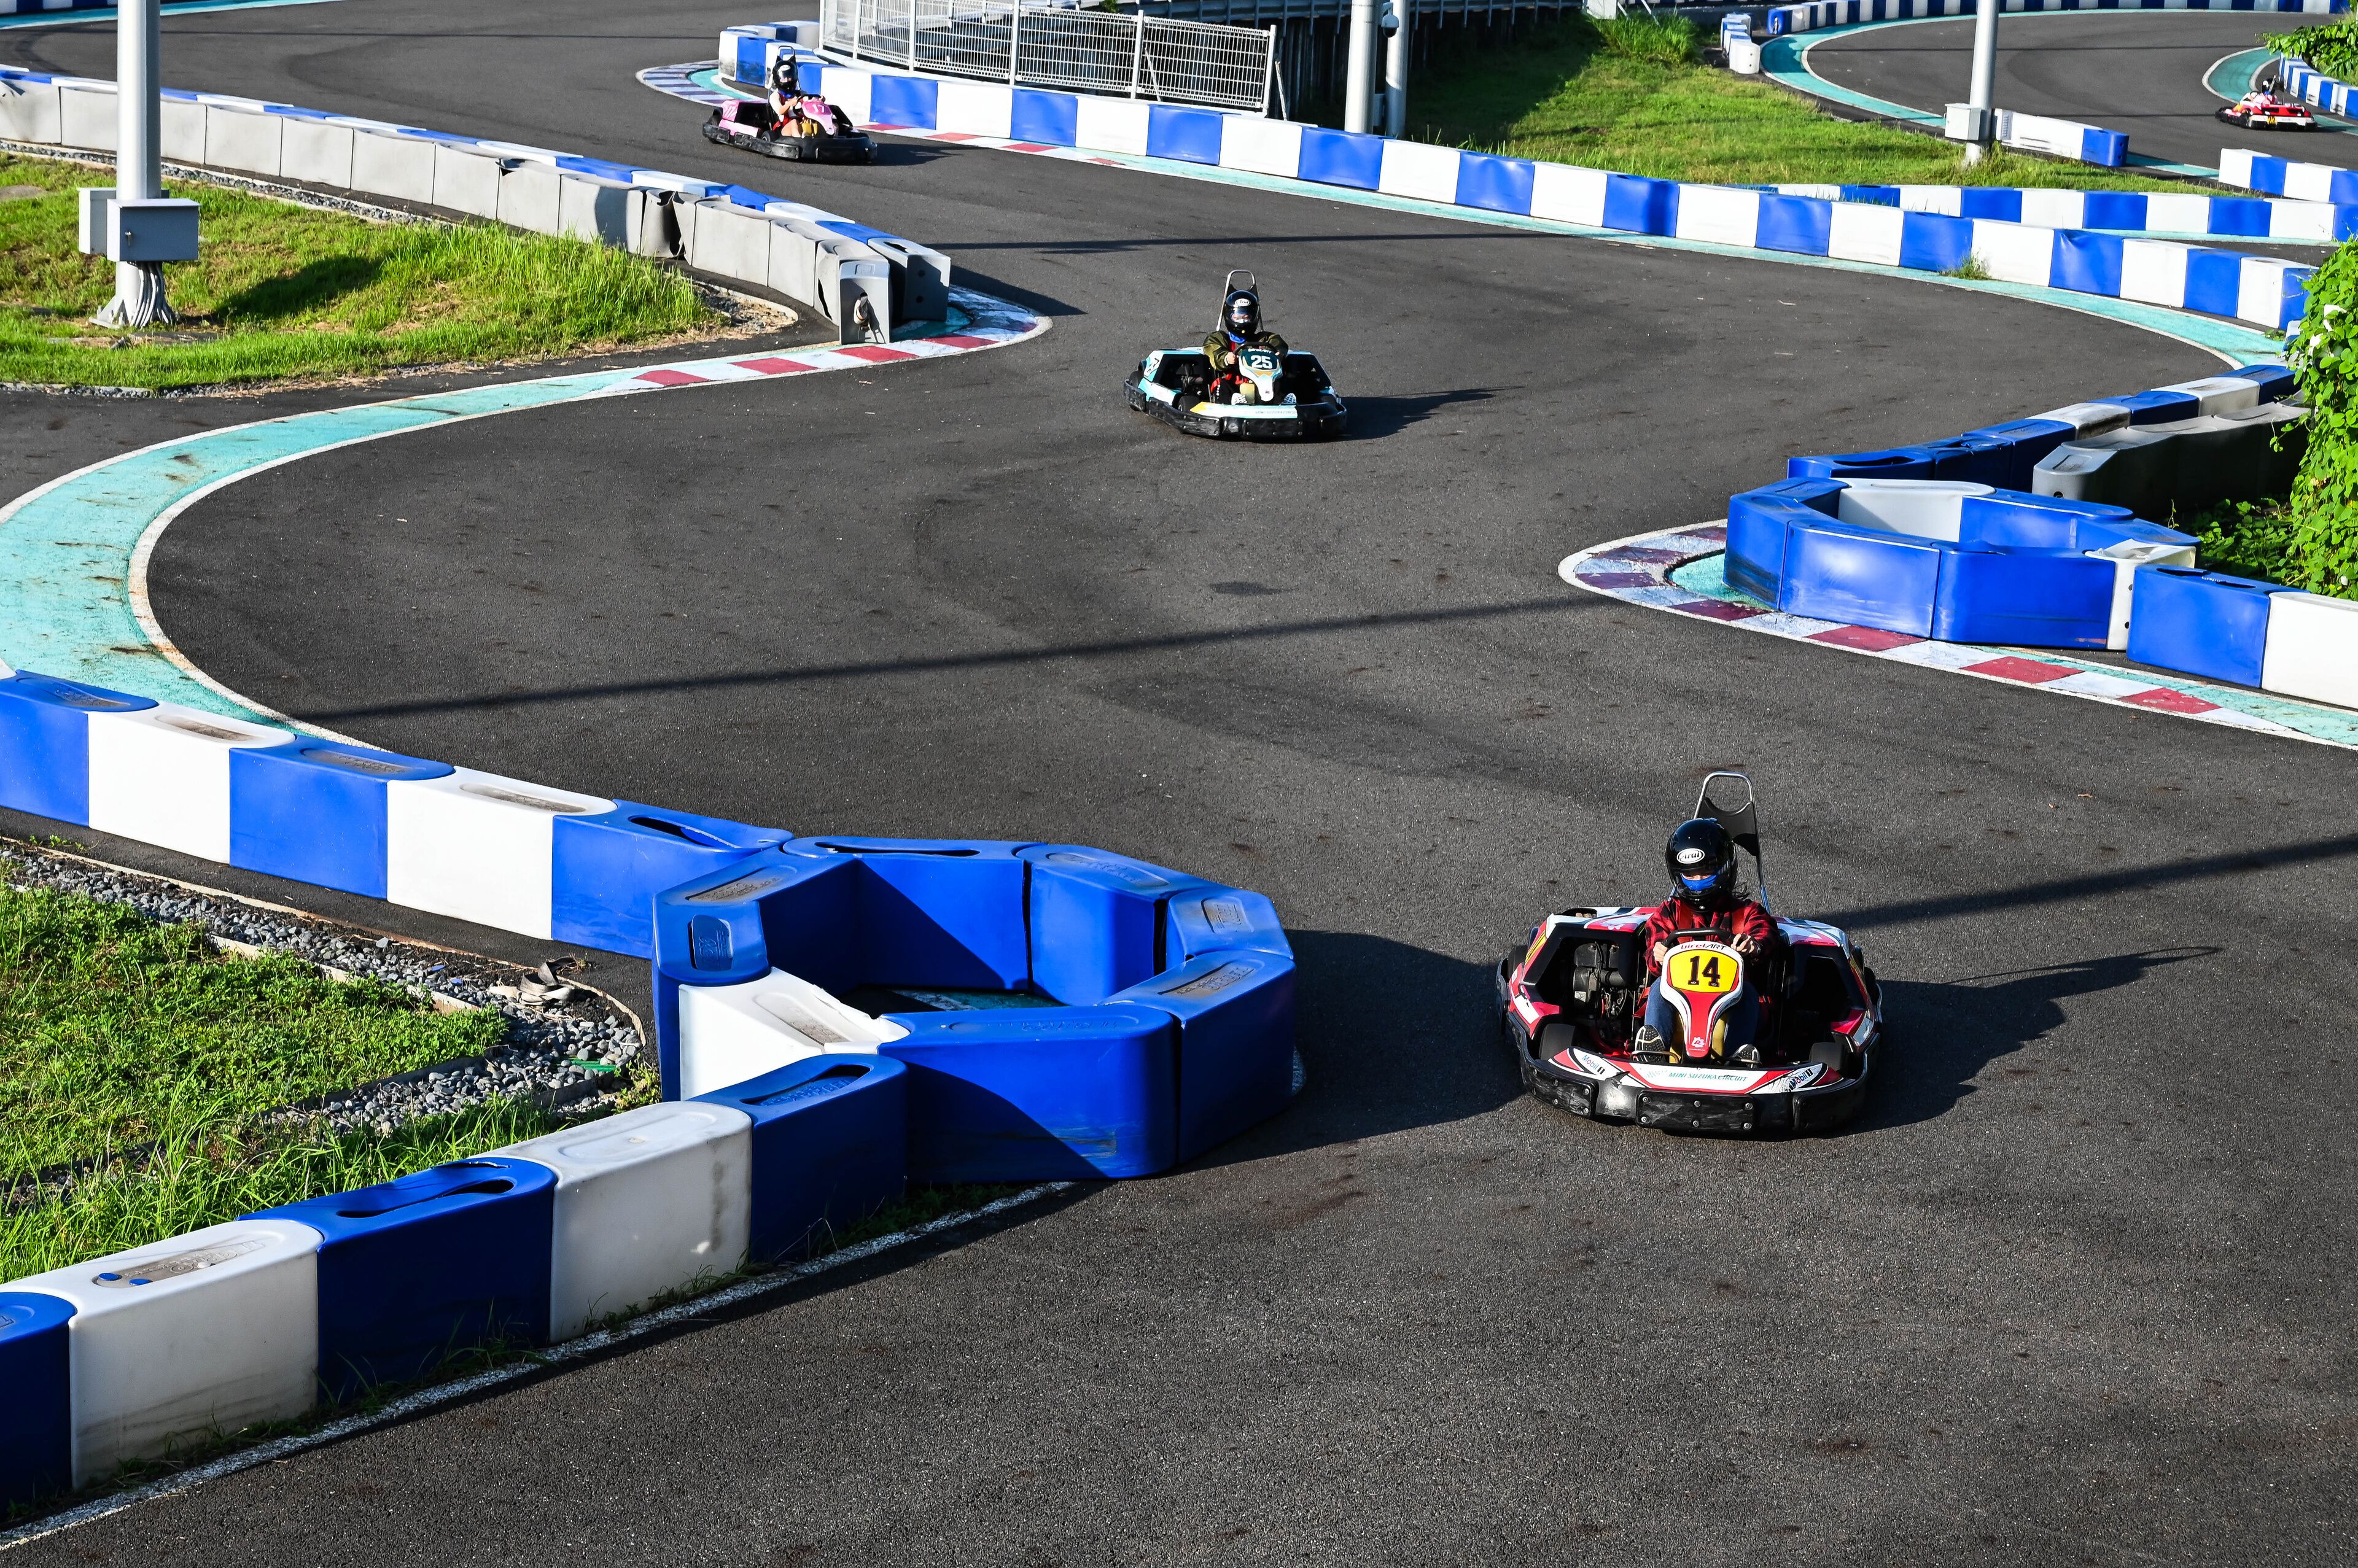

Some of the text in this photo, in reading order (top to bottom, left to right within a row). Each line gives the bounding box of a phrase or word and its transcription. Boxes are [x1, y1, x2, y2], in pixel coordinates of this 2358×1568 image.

[812, 104, 825, 113] 17
[1250, 355, 1273, 369] 25
[1679, 850, 1700, 860] Arai
[1687, 955, 1721, 987] 14
[1581, 1054, 1600, 1070] Mobil
[1789, 1071, 1808, 1089] Mobil
